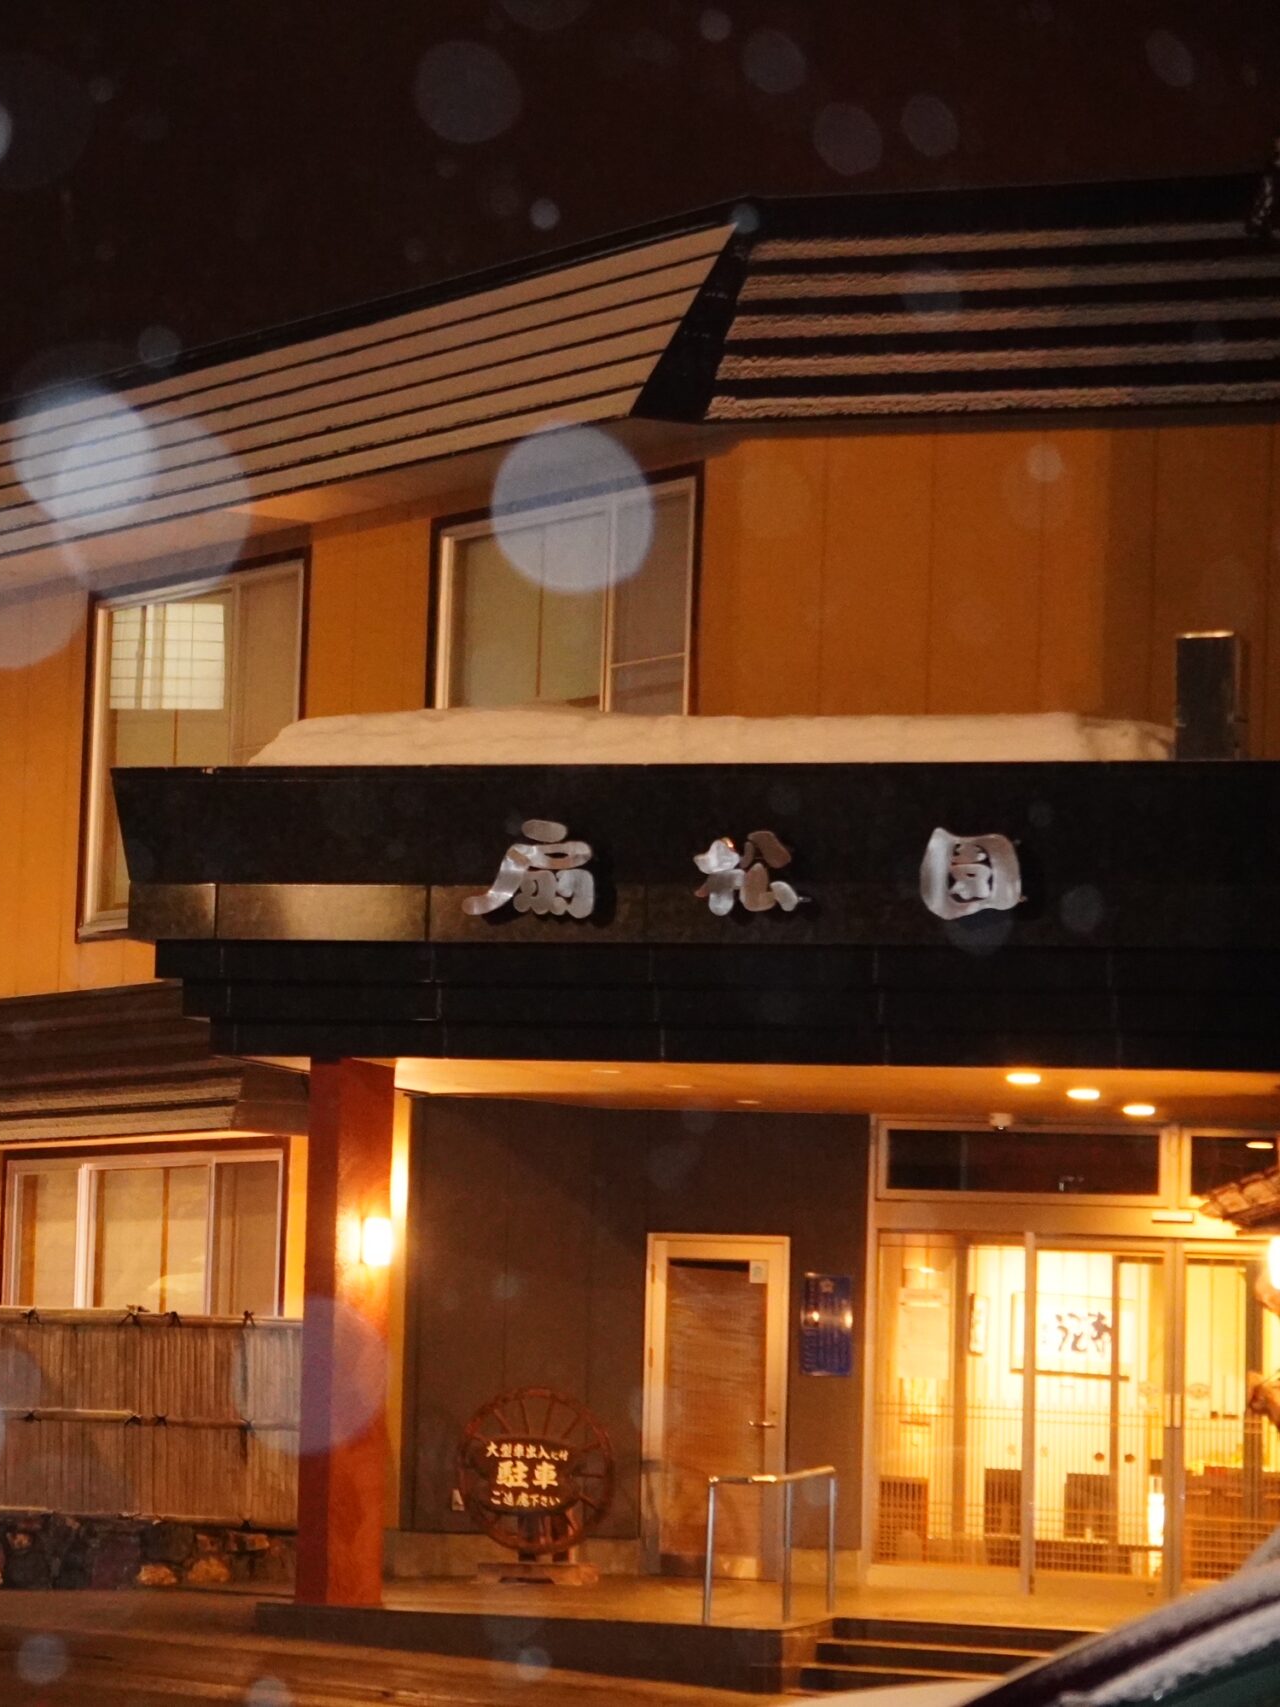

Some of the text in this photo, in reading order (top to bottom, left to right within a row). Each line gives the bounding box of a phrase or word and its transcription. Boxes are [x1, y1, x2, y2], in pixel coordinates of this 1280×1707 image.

[462, 819, 1021, 919] 扇松園
[496, 1461, 558, 1490] 駐車
